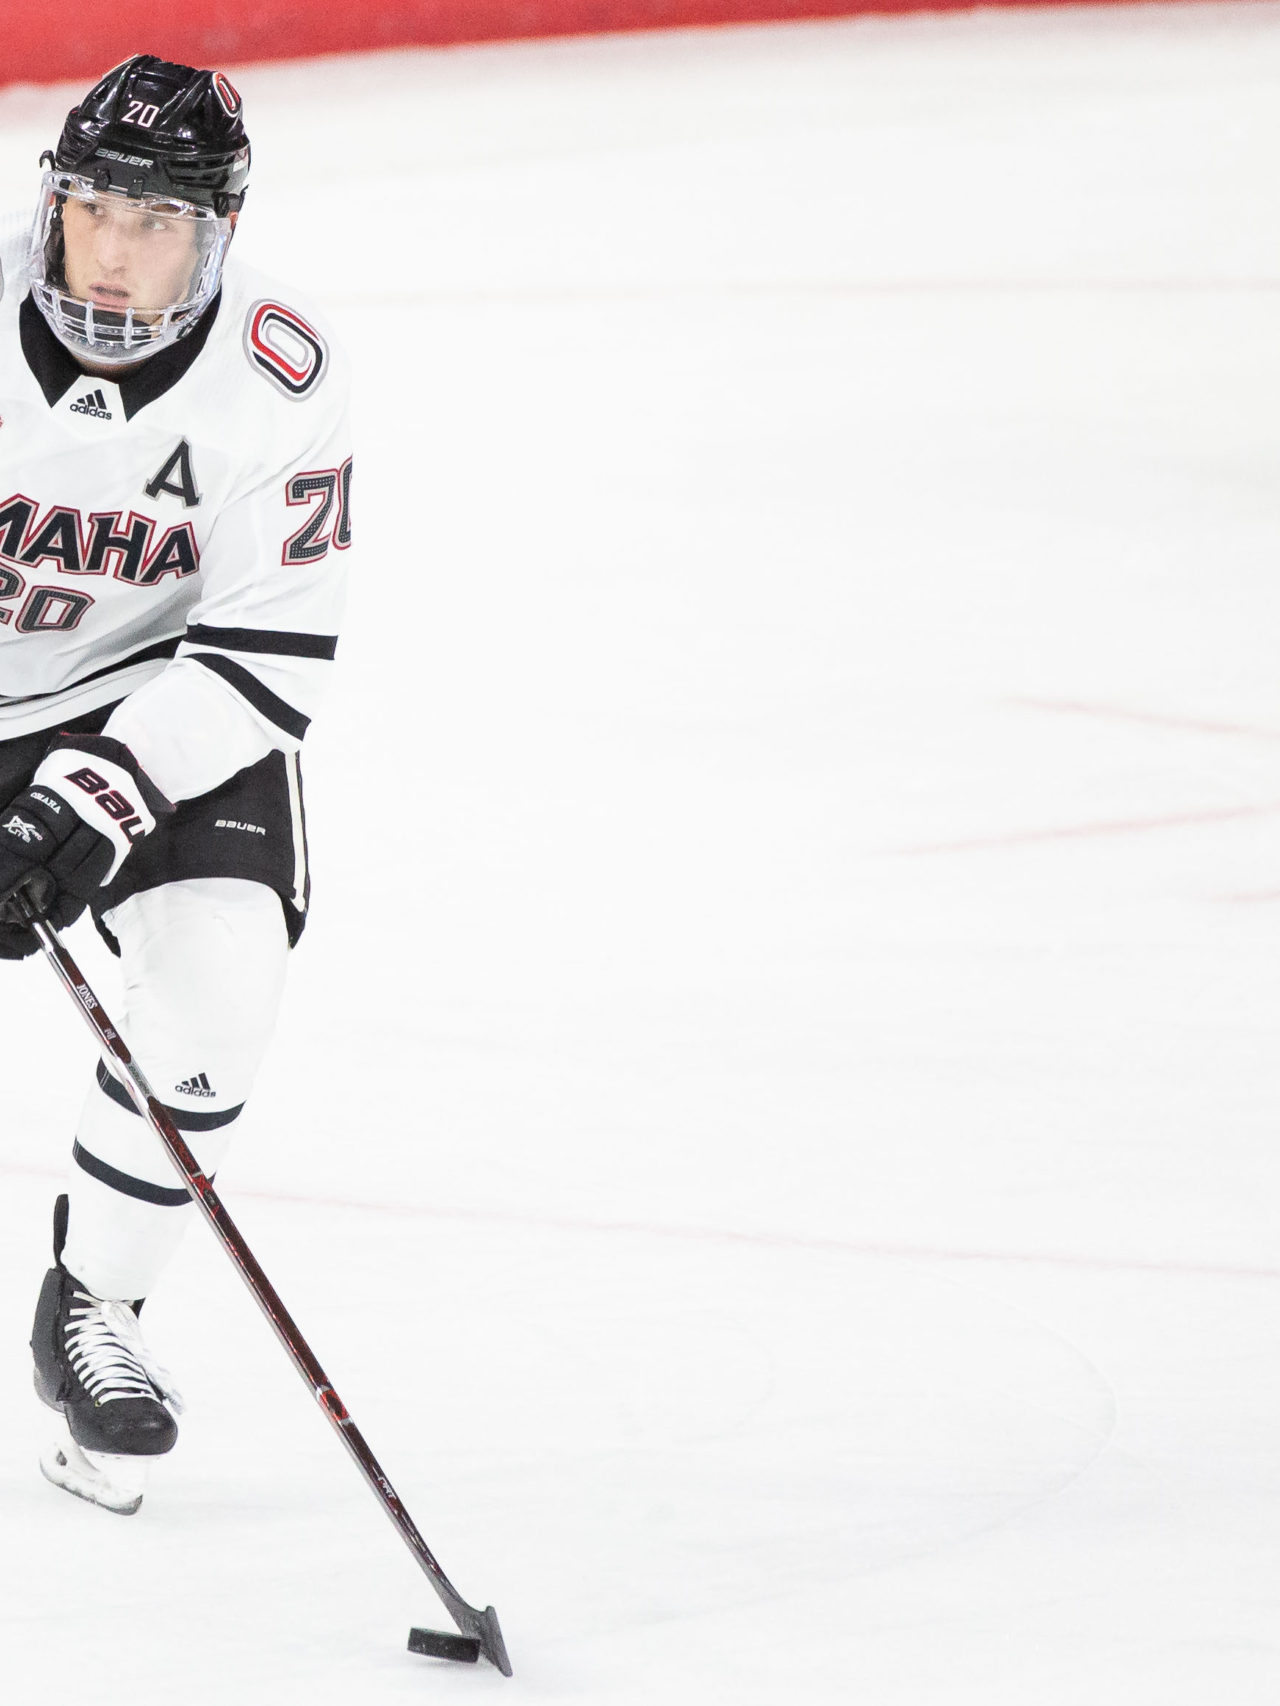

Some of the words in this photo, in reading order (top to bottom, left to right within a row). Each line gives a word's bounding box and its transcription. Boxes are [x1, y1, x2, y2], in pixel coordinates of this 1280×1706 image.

[121, 100, 160, 128] 20
[95, 148, 154, 168] BAUER
[70, 403, 112, 420] adidas
[143, 436, 203, 509] A
[215, 819, 266, 836] BAUER
[76, 983, 98, 1010] JONES
[175, 1084, 216, 1098] adidas
